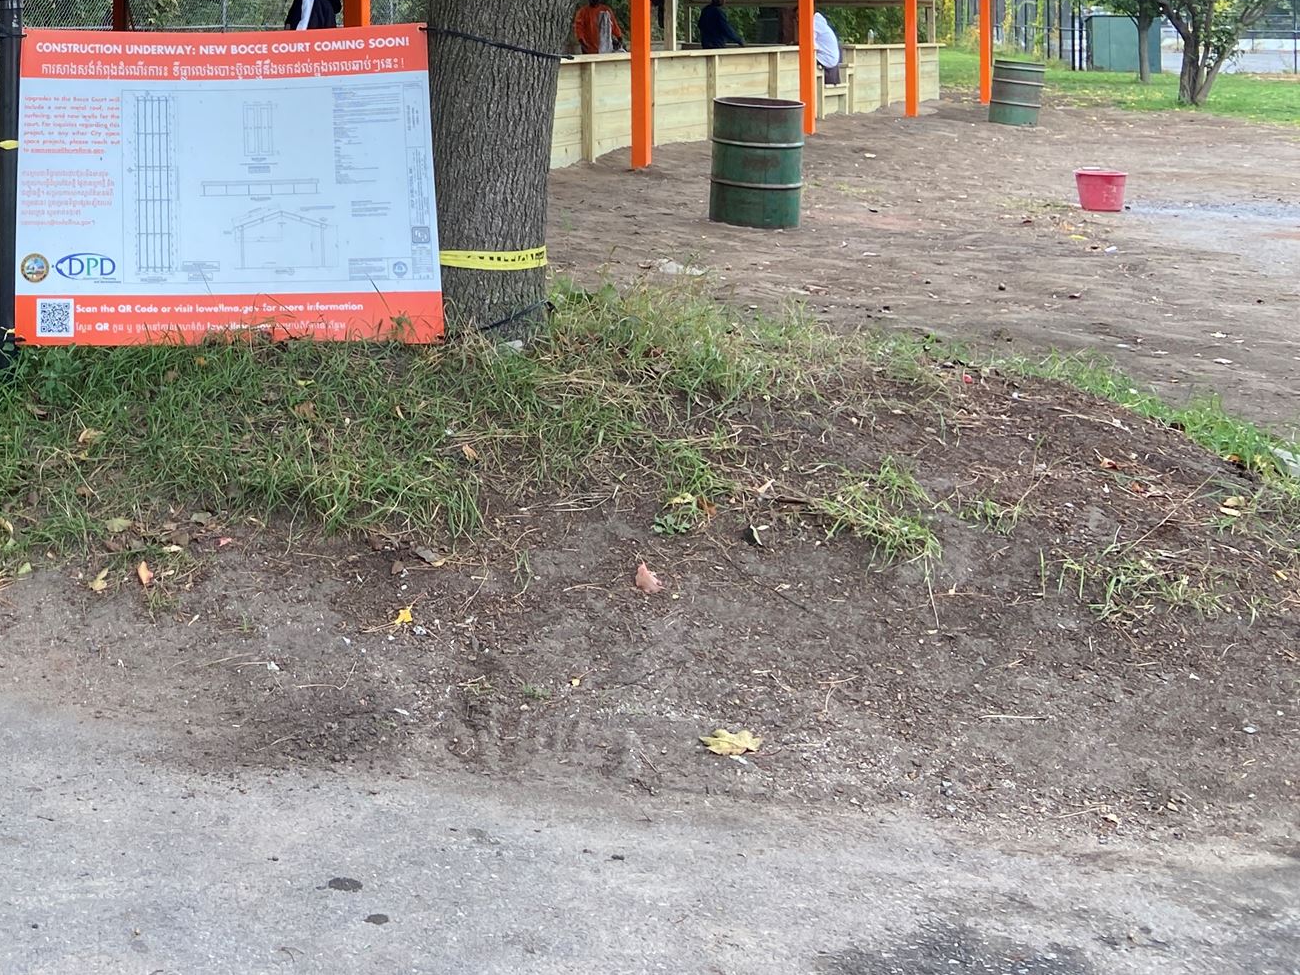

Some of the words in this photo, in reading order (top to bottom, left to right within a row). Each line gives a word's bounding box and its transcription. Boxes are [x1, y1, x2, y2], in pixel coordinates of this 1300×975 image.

[36, 42, 122, 54] CONSTRUCTION
[126, 44, 196, 55] UNDERWAY:
[199, 45, 227, 55] NEW
[231, 44, 268, 54] BOCCE
[271, 42, 310, 53] COURT
[314, 39, 365, 51] COMING
[369, 37, 410, 49] SOON!
[68, 257, 116, 276] DPD
[76, 304, 98, 313] Scan
[100, 304, 115, 313] the
[118, 304, 132, 314] QR
[135, 304, 158, 313] Code
[174, 304, 193, 313] visit
[196, 304, 259, 315] lowellma.gov
[263, 303, 276, 312] for
[279, 304, 304, 312] more
[307, 301, 364, 312] information
[95, 322, 110, 332] QR
